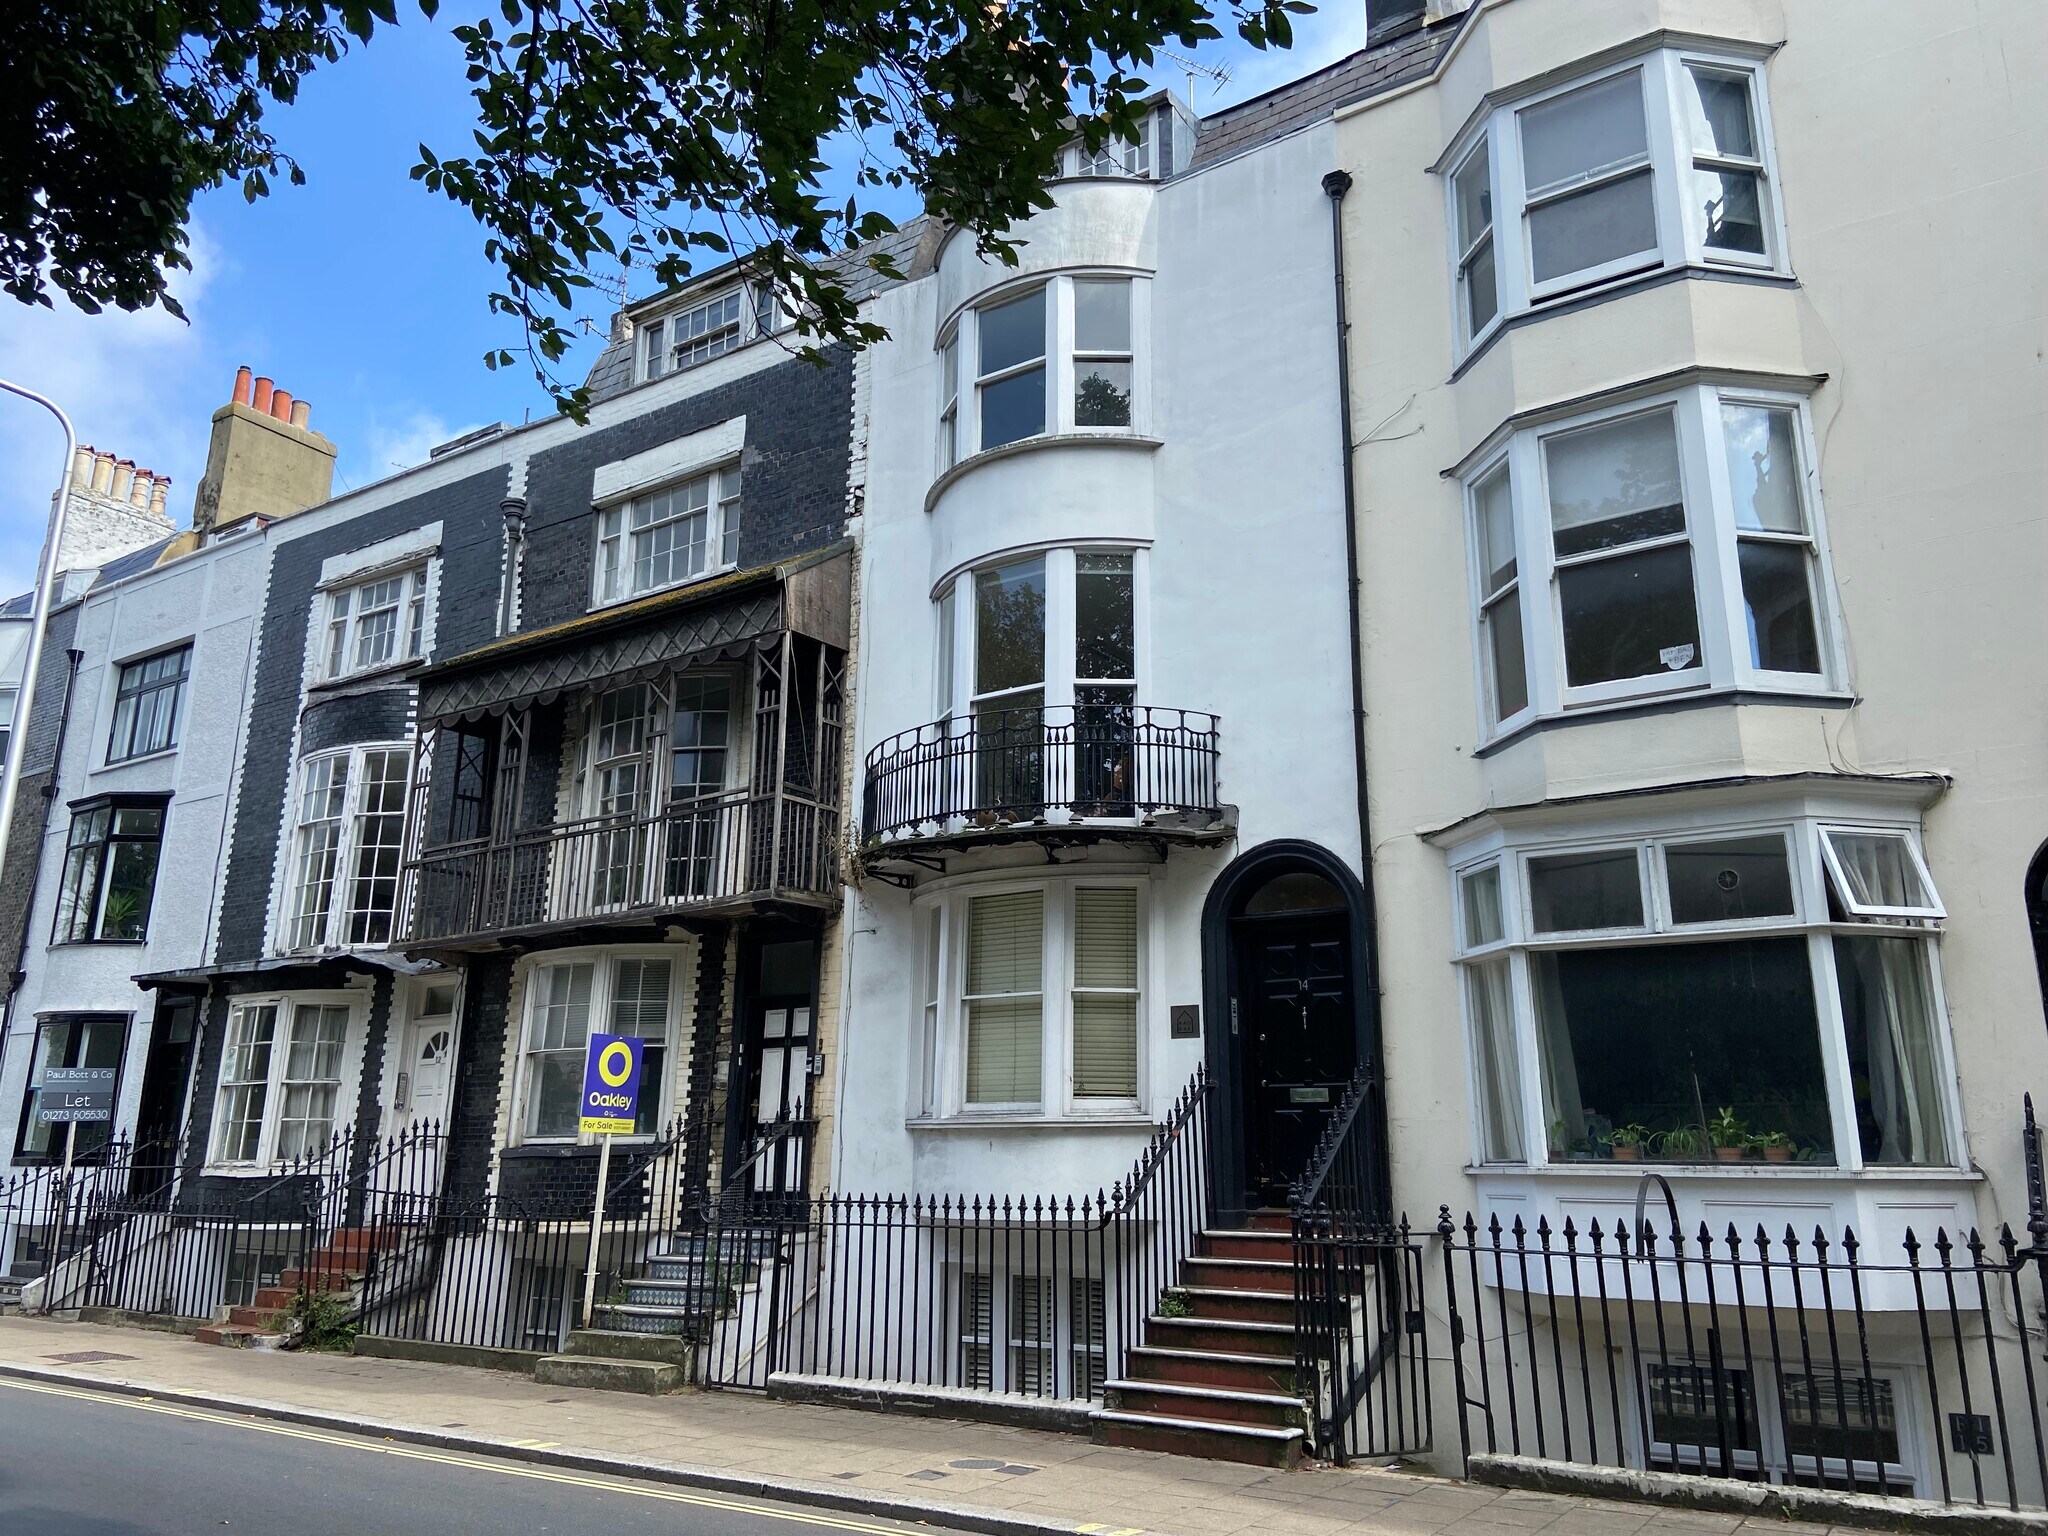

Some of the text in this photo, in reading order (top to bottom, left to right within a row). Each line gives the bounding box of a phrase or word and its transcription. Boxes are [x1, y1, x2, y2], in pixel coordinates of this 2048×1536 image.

[1298, 979, 1308, 990] 14
[435, 1056, 442, 1064] 12
[46, 1070, 66, 1079] Paul
[69, 1070, 88, 1079] Bott
[101, 1070, 112, 1078] Co
[65, 1094, 91, 1107] Let
[589, 1091, 633, 1111] Oakley
[42, 1110, 108, 1120] 01273 605530
[583, 1120, 595, 1129] For
[596, 1120, 613, 1130] Sale
